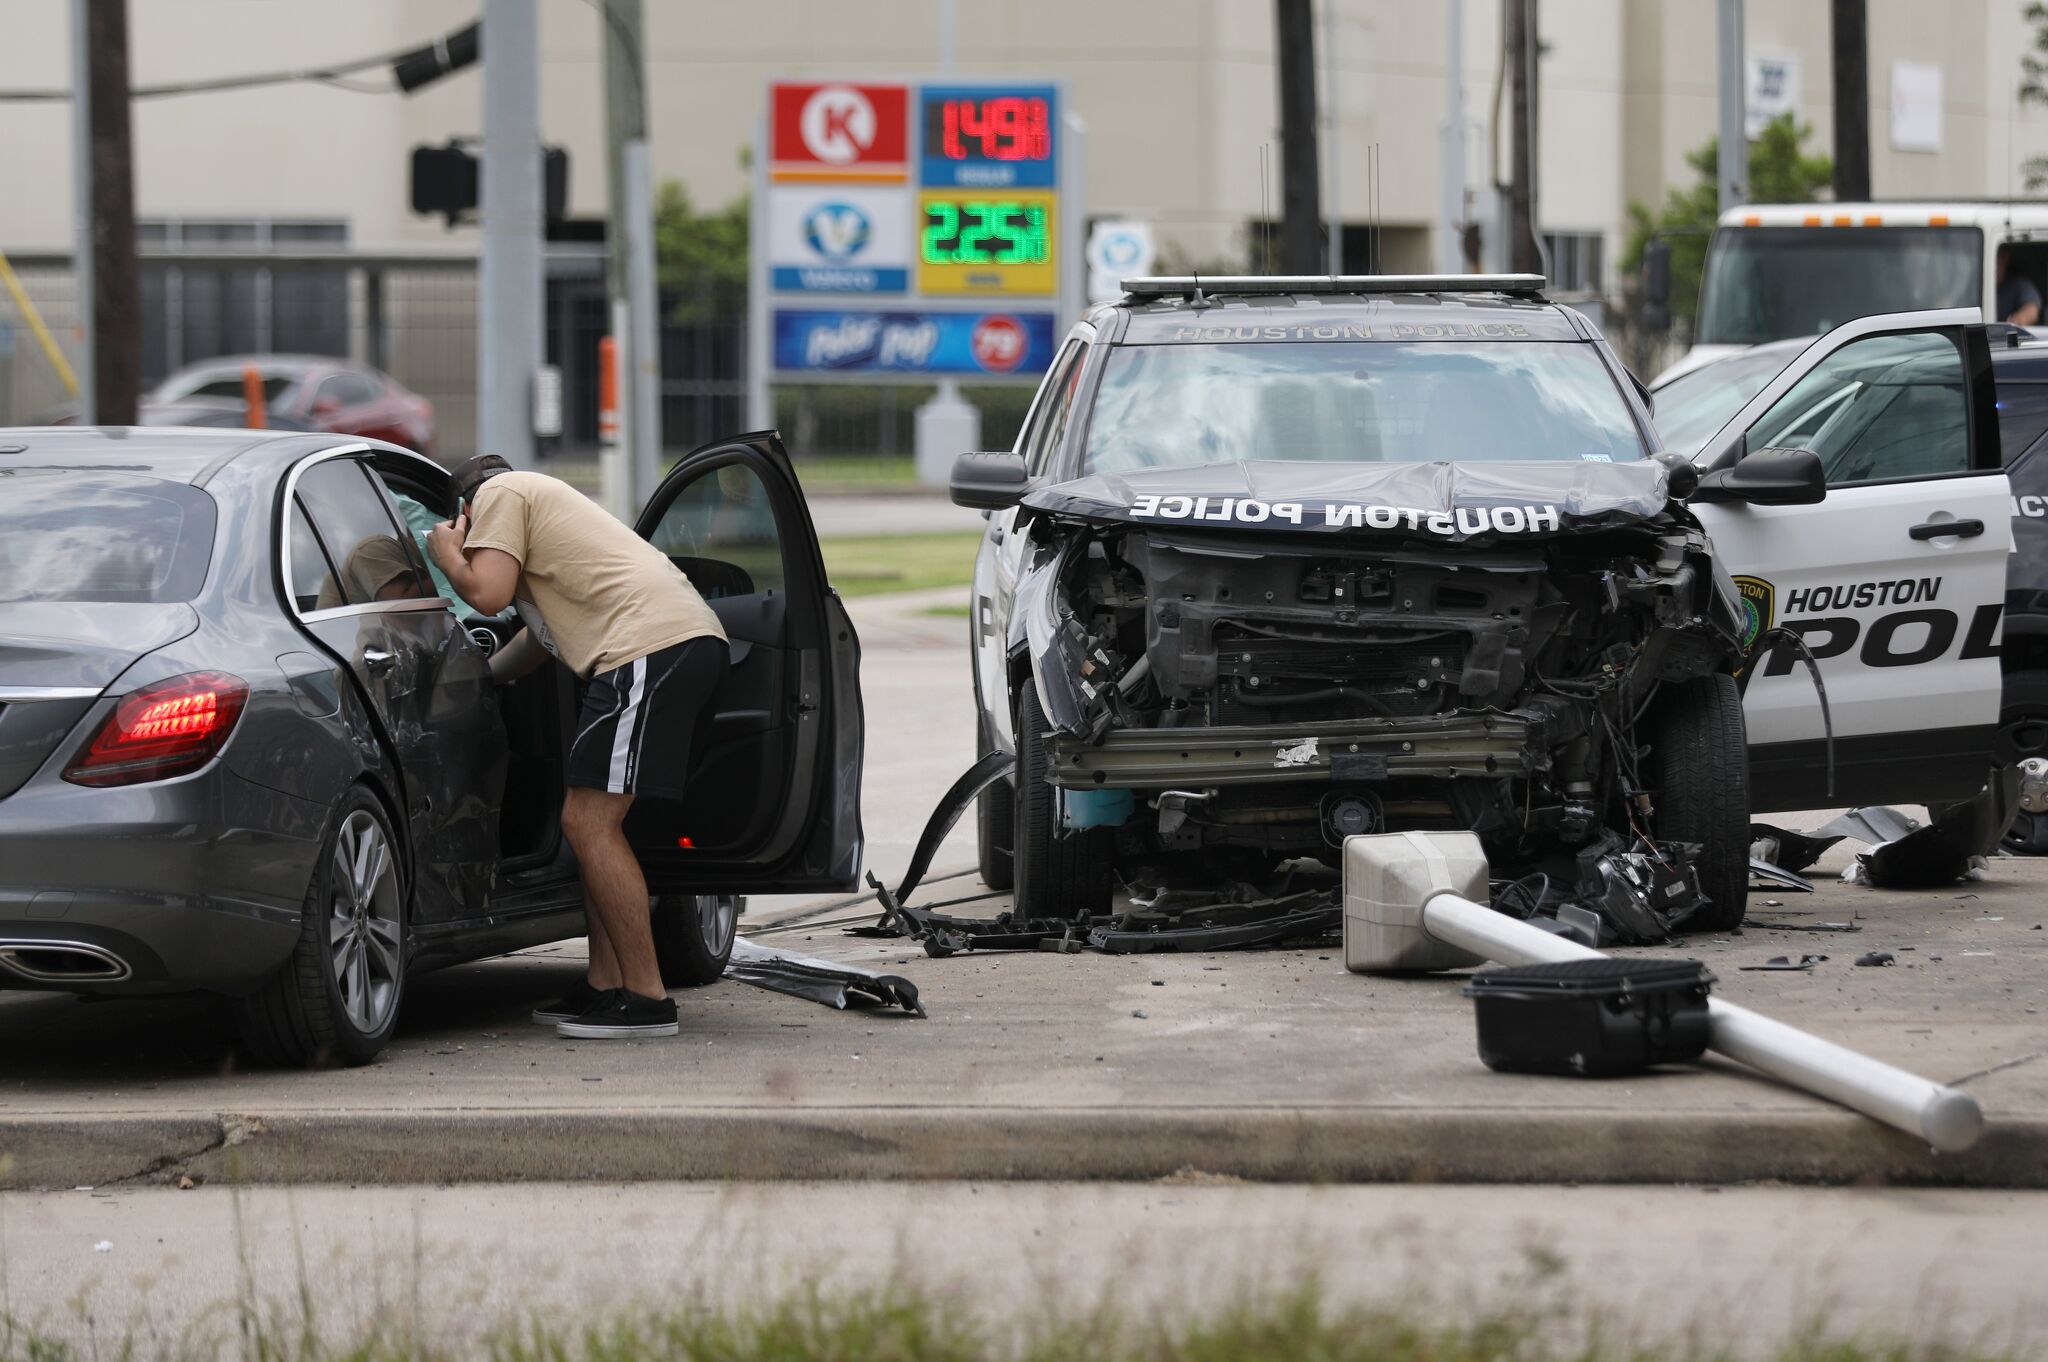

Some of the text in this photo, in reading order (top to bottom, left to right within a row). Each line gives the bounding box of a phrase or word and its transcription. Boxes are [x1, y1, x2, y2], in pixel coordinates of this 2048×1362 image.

[1173, 324, 1530, 341] HOUSTON POLICE
[1784, 577, 1942, 614] HOUSTON
